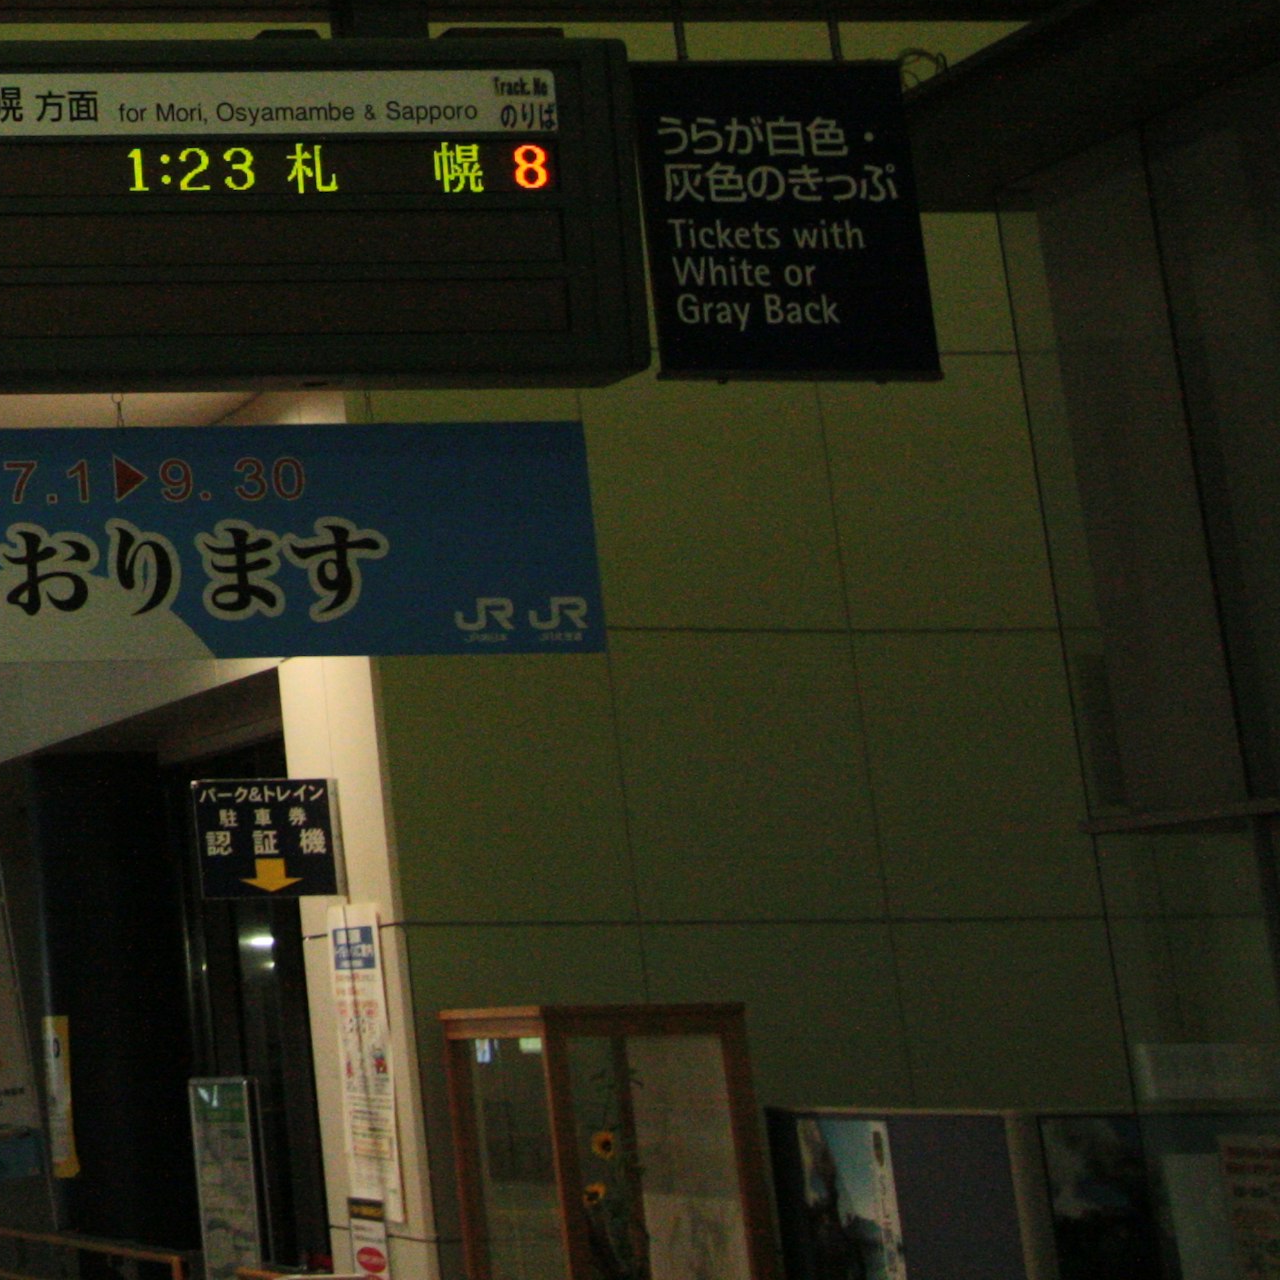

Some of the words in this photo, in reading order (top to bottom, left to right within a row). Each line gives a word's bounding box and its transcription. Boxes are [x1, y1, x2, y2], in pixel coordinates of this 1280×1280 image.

[119, 103, 147, 123] for
[156, 102, 208, 125] Mori,
[216, 101, 355, 127] Osyamambe
[366, 105, 376, 120] &
[387, 101, 478, 125] Sapporo
[501, 103, 556, 130] のりば
[127, 147, 255, 193] 1:23
[513, 144, 548, 190] 8
[664, 162, 899, 202] 灰色のきっぷ
[667, 218, 781, 249] Tickets
[792, 218, 866, 249] with
[672, 256, 771, 287] White
[784, 263, 816, 287] or
[677, 293, 751, 332] Gray
[763, 293, 842, 324] Back
[454, 596, 515, 631] JR
[528, 596, 588, 630] JR
